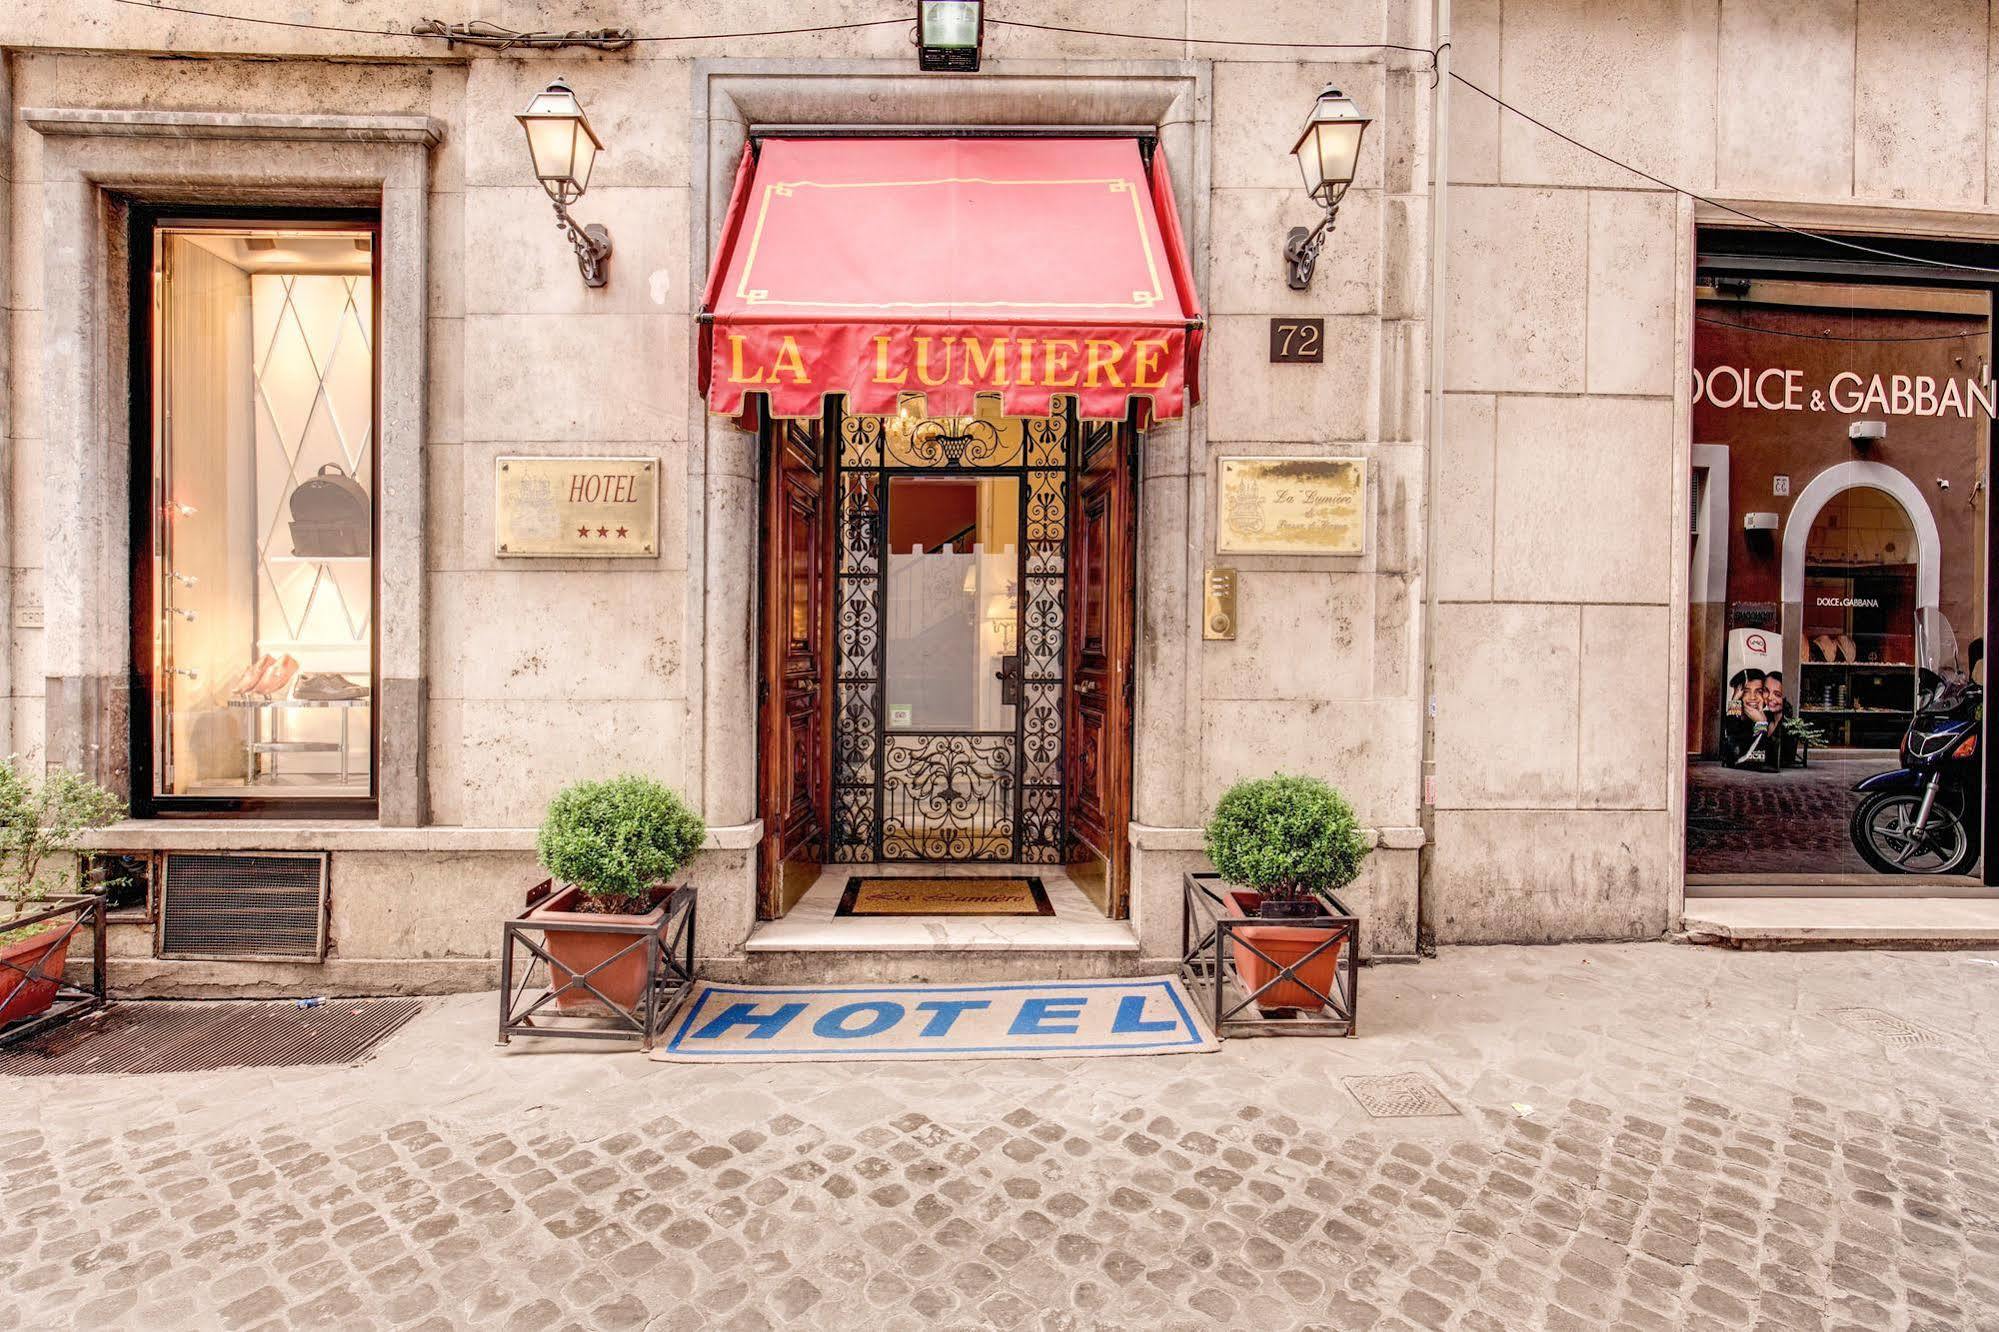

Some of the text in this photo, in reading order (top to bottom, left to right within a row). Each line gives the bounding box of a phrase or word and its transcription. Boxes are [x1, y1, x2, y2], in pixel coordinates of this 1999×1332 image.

[1278, 325, 1319, 356] 72
[727, 335, 1170, 388] LA LUMIERE
[569, 474, 638, 503] HOTEL
[690, 995, 1178, 1039] HOTEL
